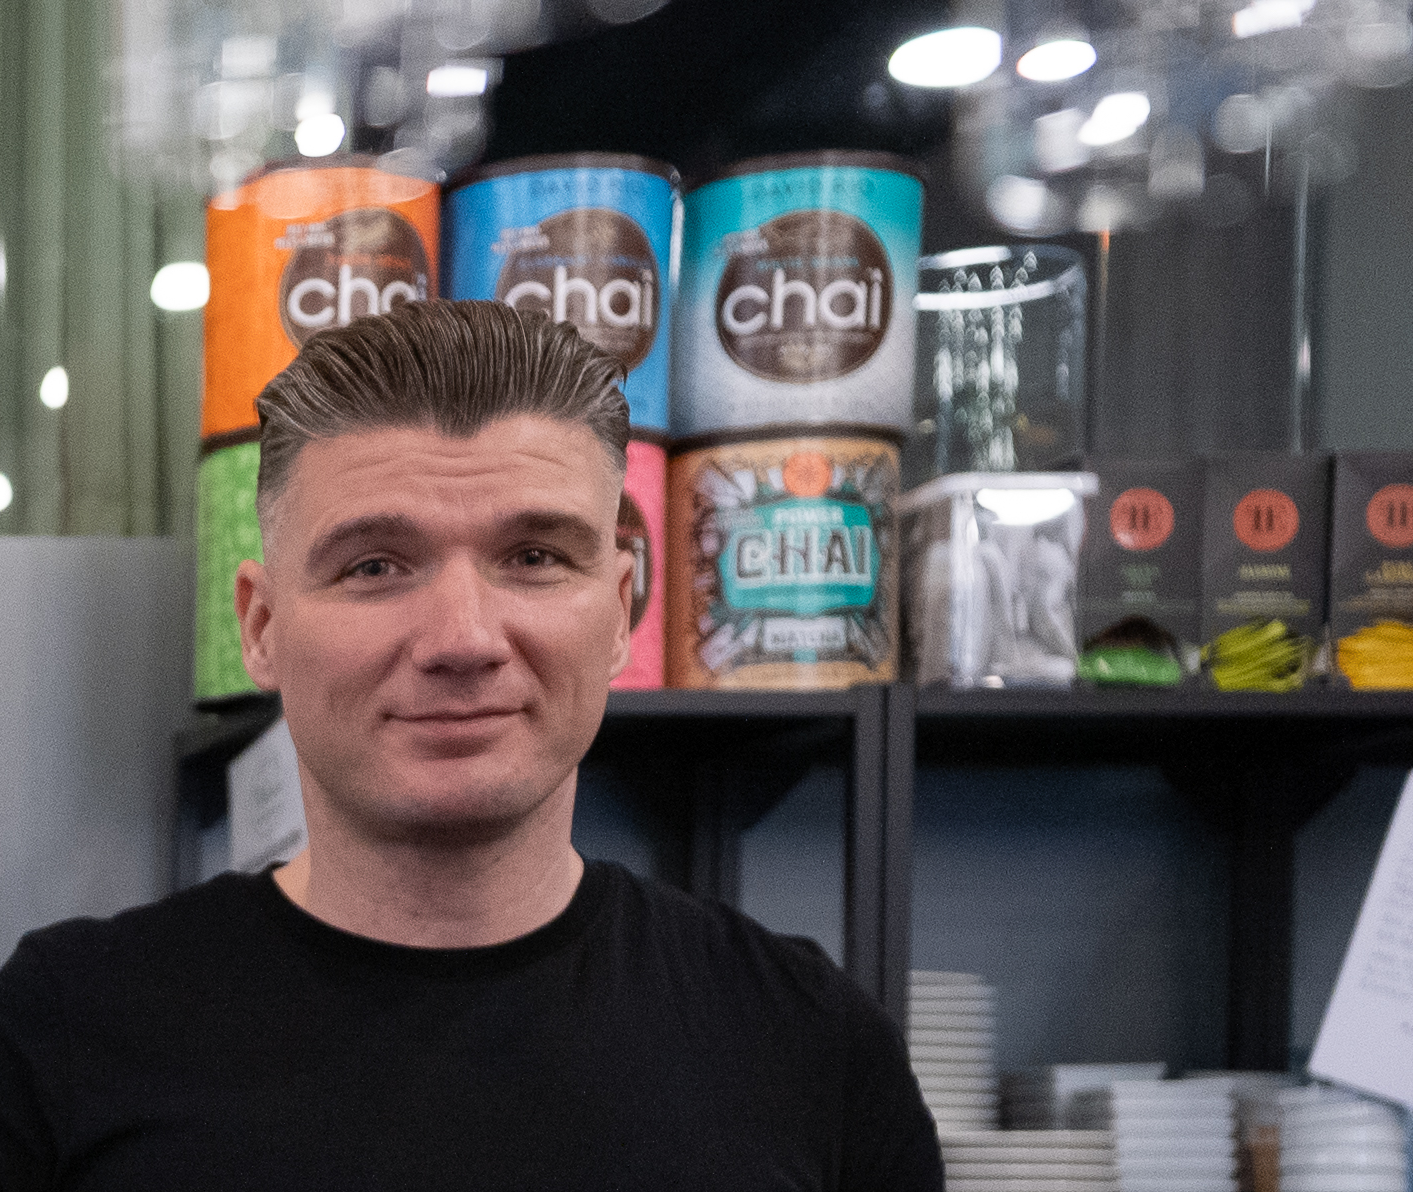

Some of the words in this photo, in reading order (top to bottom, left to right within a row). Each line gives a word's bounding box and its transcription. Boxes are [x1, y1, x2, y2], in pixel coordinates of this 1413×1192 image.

[723, 268, 883, 335] chai
[774, 507, 843, 524] POWER
[733, 526, 871, 583] CHAI
